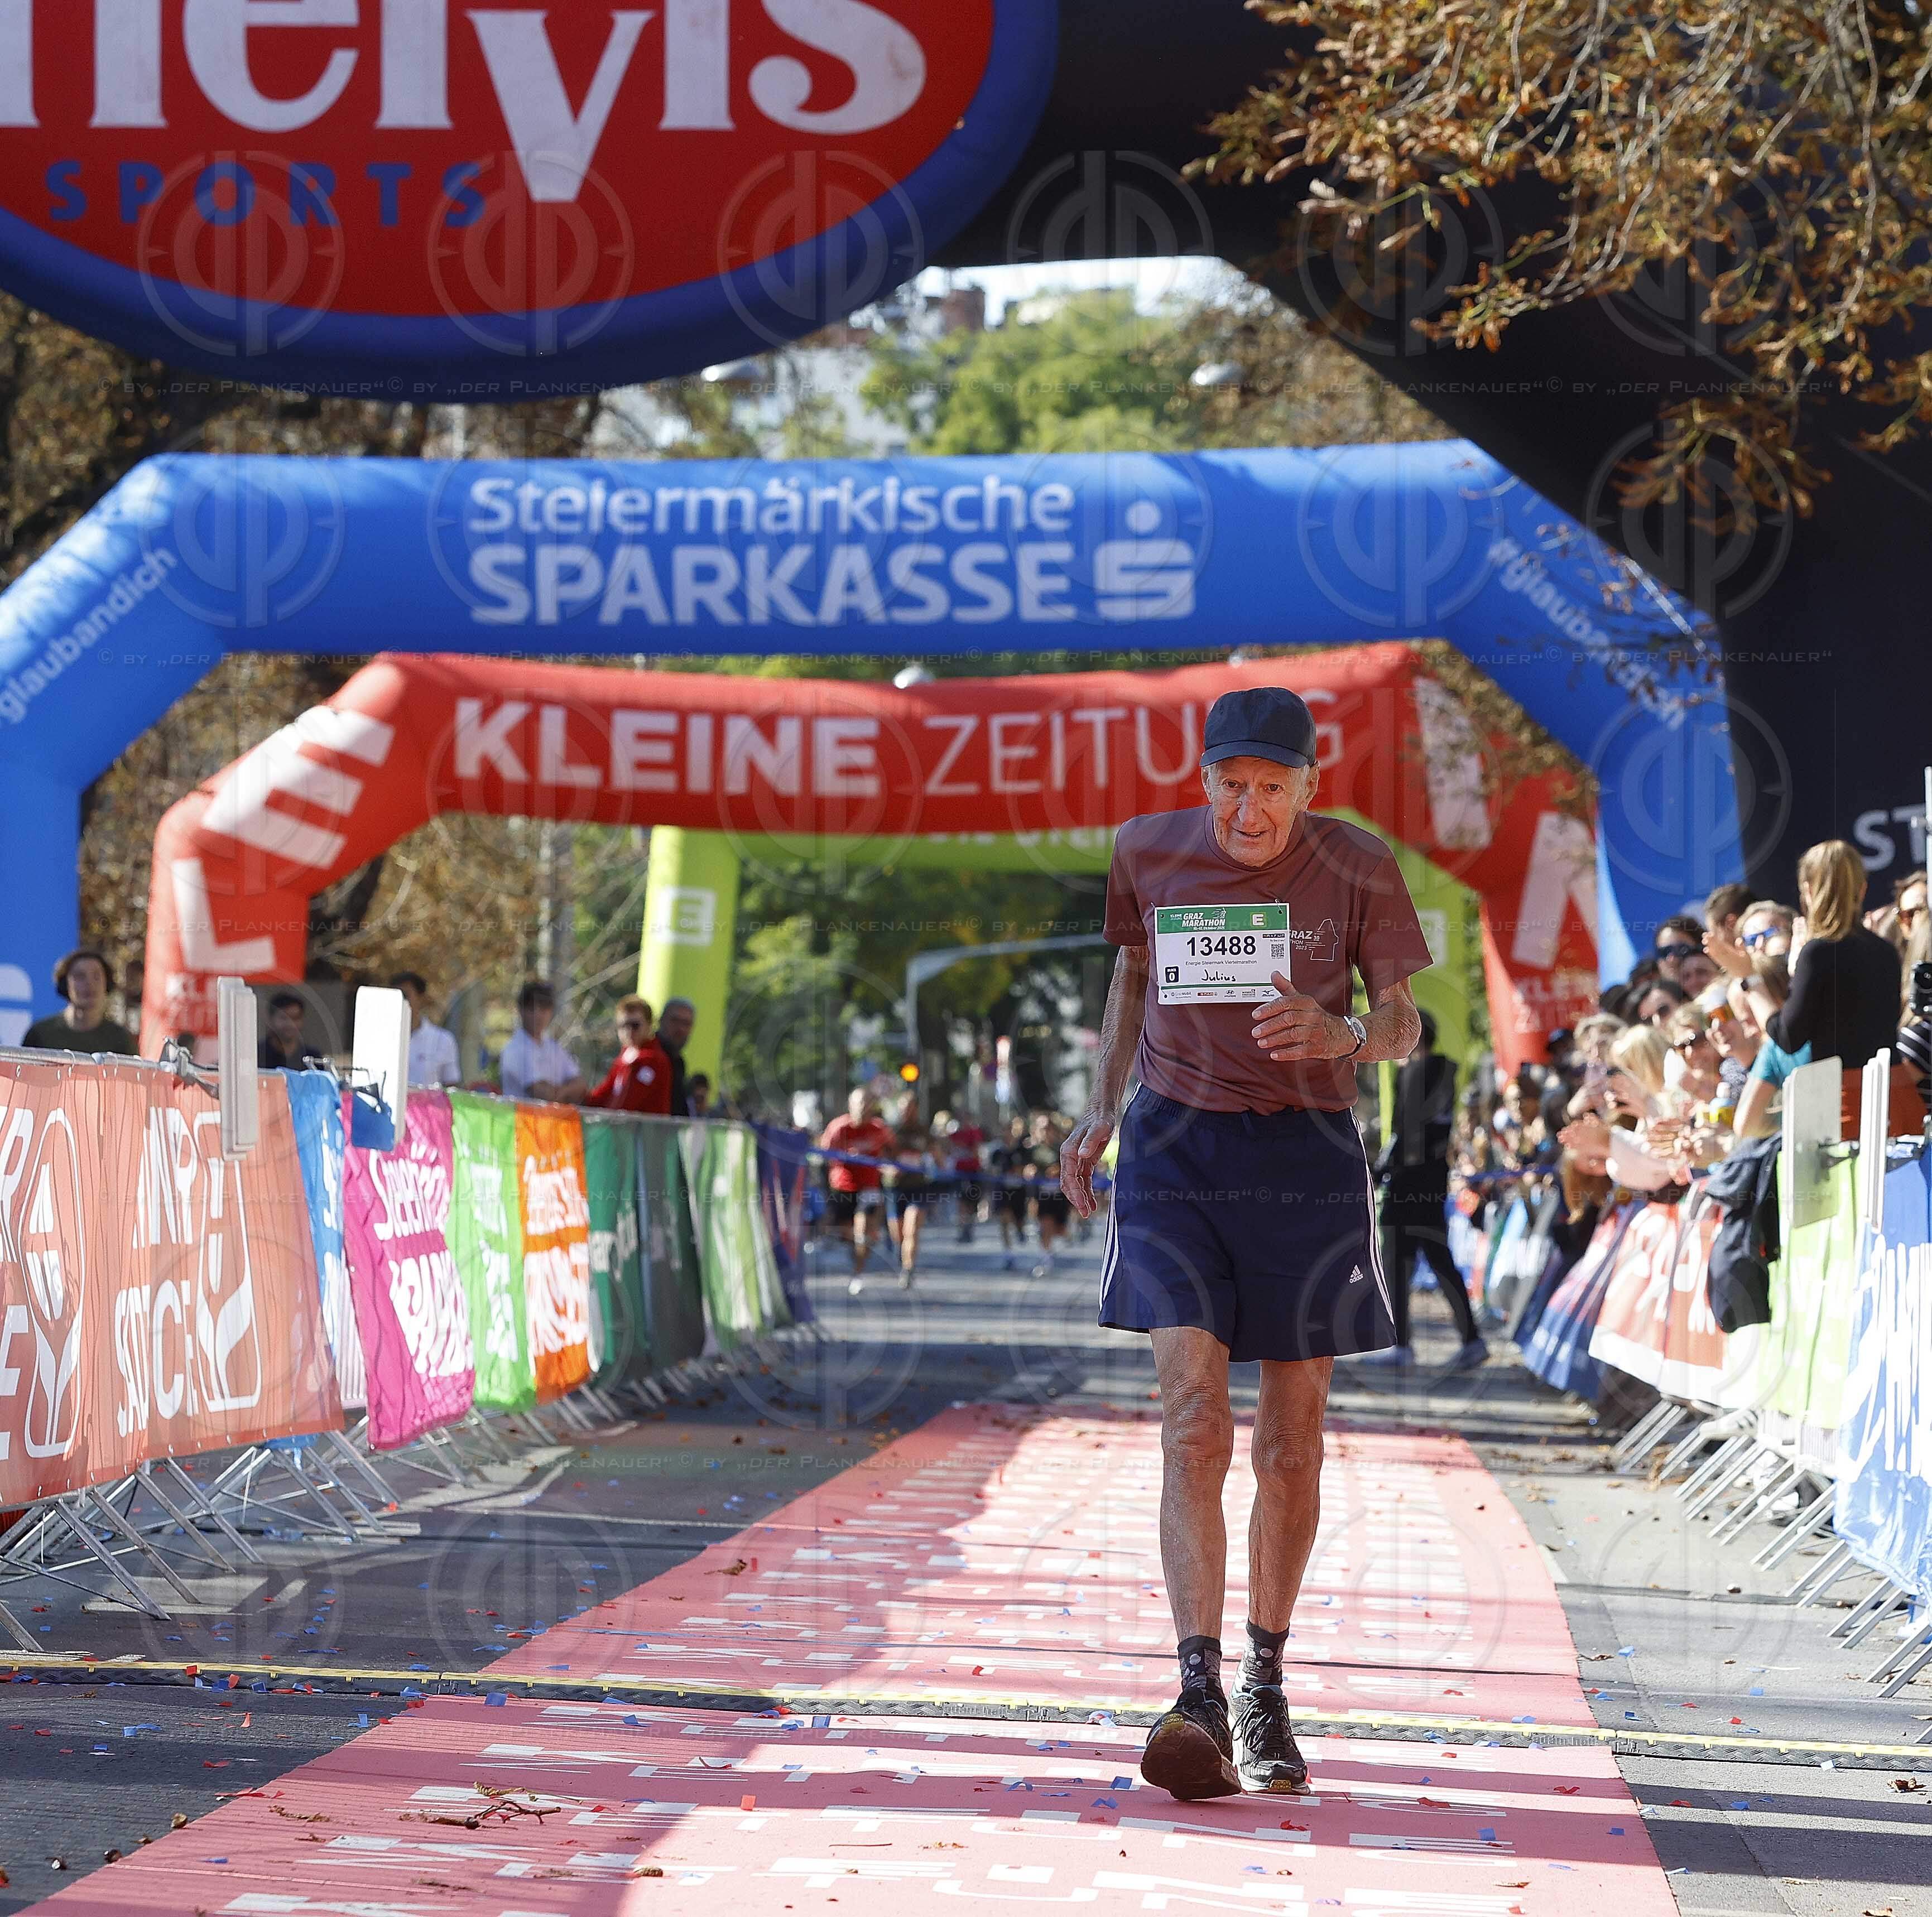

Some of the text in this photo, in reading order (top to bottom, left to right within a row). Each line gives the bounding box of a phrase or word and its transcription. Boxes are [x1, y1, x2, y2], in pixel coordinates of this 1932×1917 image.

[46, 160, 487, 228] SPORTS
[469, 475, 1075, 536] Steiermärkische
[469, 543, 1078, 626] SPARKASSE
[453, 690, 1343, 798] KLEINE ZEITUG
[1181, 918, 1225, 927] MARATHON
[1183, 912, 1204, 921] GRAZ
[1290, 929, 1313, 940] RAZ
[1186, 936, 1256, 957] 13488
[1169, 972, 1175, 981] 0
[1201, 969, 1236, 982] Julius
[1349, 1273, 1364, 1284] adidas
